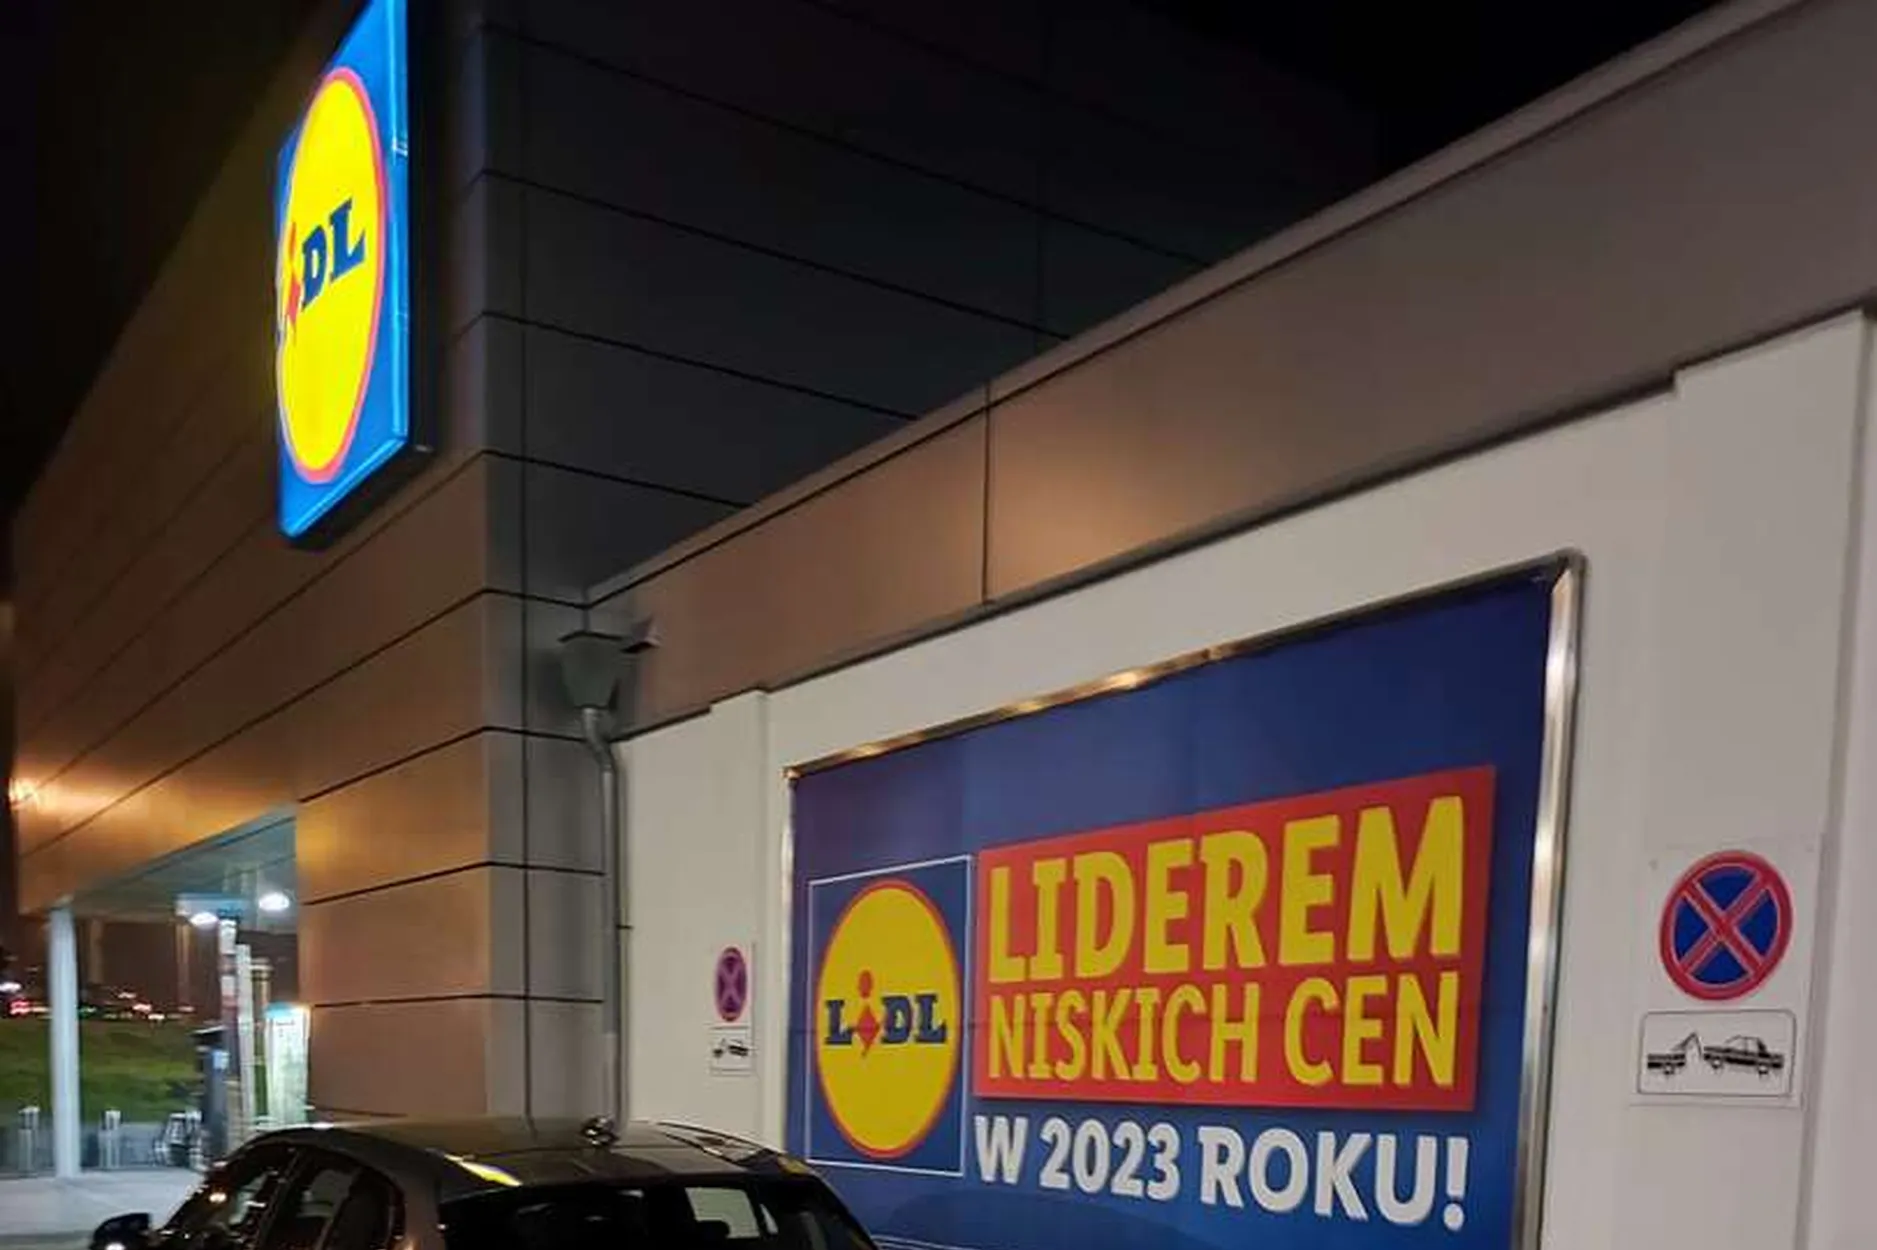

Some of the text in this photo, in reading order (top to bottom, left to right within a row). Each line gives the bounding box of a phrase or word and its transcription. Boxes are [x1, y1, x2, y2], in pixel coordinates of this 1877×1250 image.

[988, 796, 1465, 982] LIDEREM
[988, 971, 1459, 1087] NISKICH CEN
[973, 1114, 1470, 1231] W 2023 ROKU!
